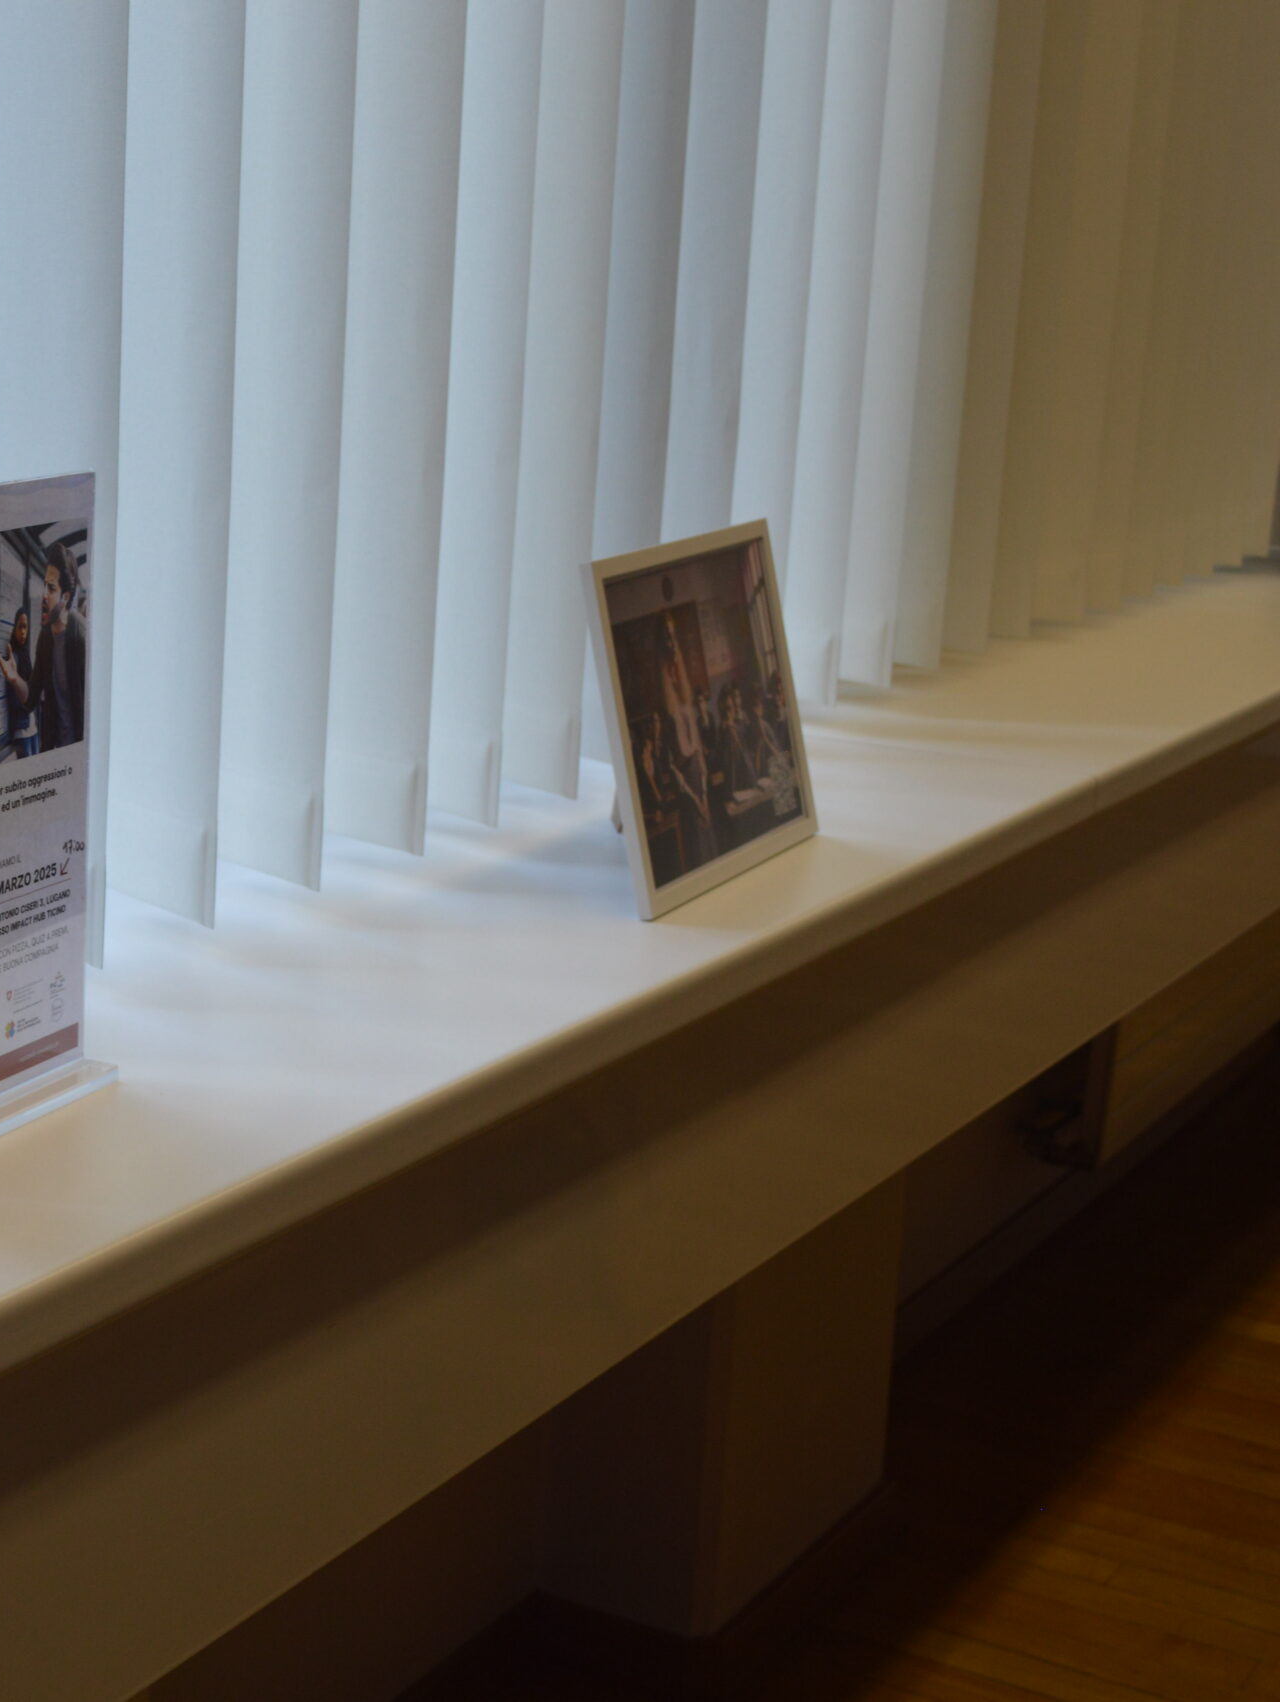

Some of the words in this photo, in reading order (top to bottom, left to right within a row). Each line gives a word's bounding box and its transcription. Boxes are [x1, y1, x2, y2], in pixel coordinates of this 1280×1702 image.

[5, 778, 27, 794] subito
[28, 766, 67, 790] aggressioni
[68, 767, 73, 775] o
[1, 800, 10, 812] ed
[16, 854, 22, 864] IL
[33, 863, 57, 884] 2025
[21, 900, 38, 914] CISERI
[46, 889, 71, 905] LUGANO
[10, 917, 32, 932] IMPACT
[33, 912, 46, 923] HUB
[47, 904, 66, 918] TICINO
